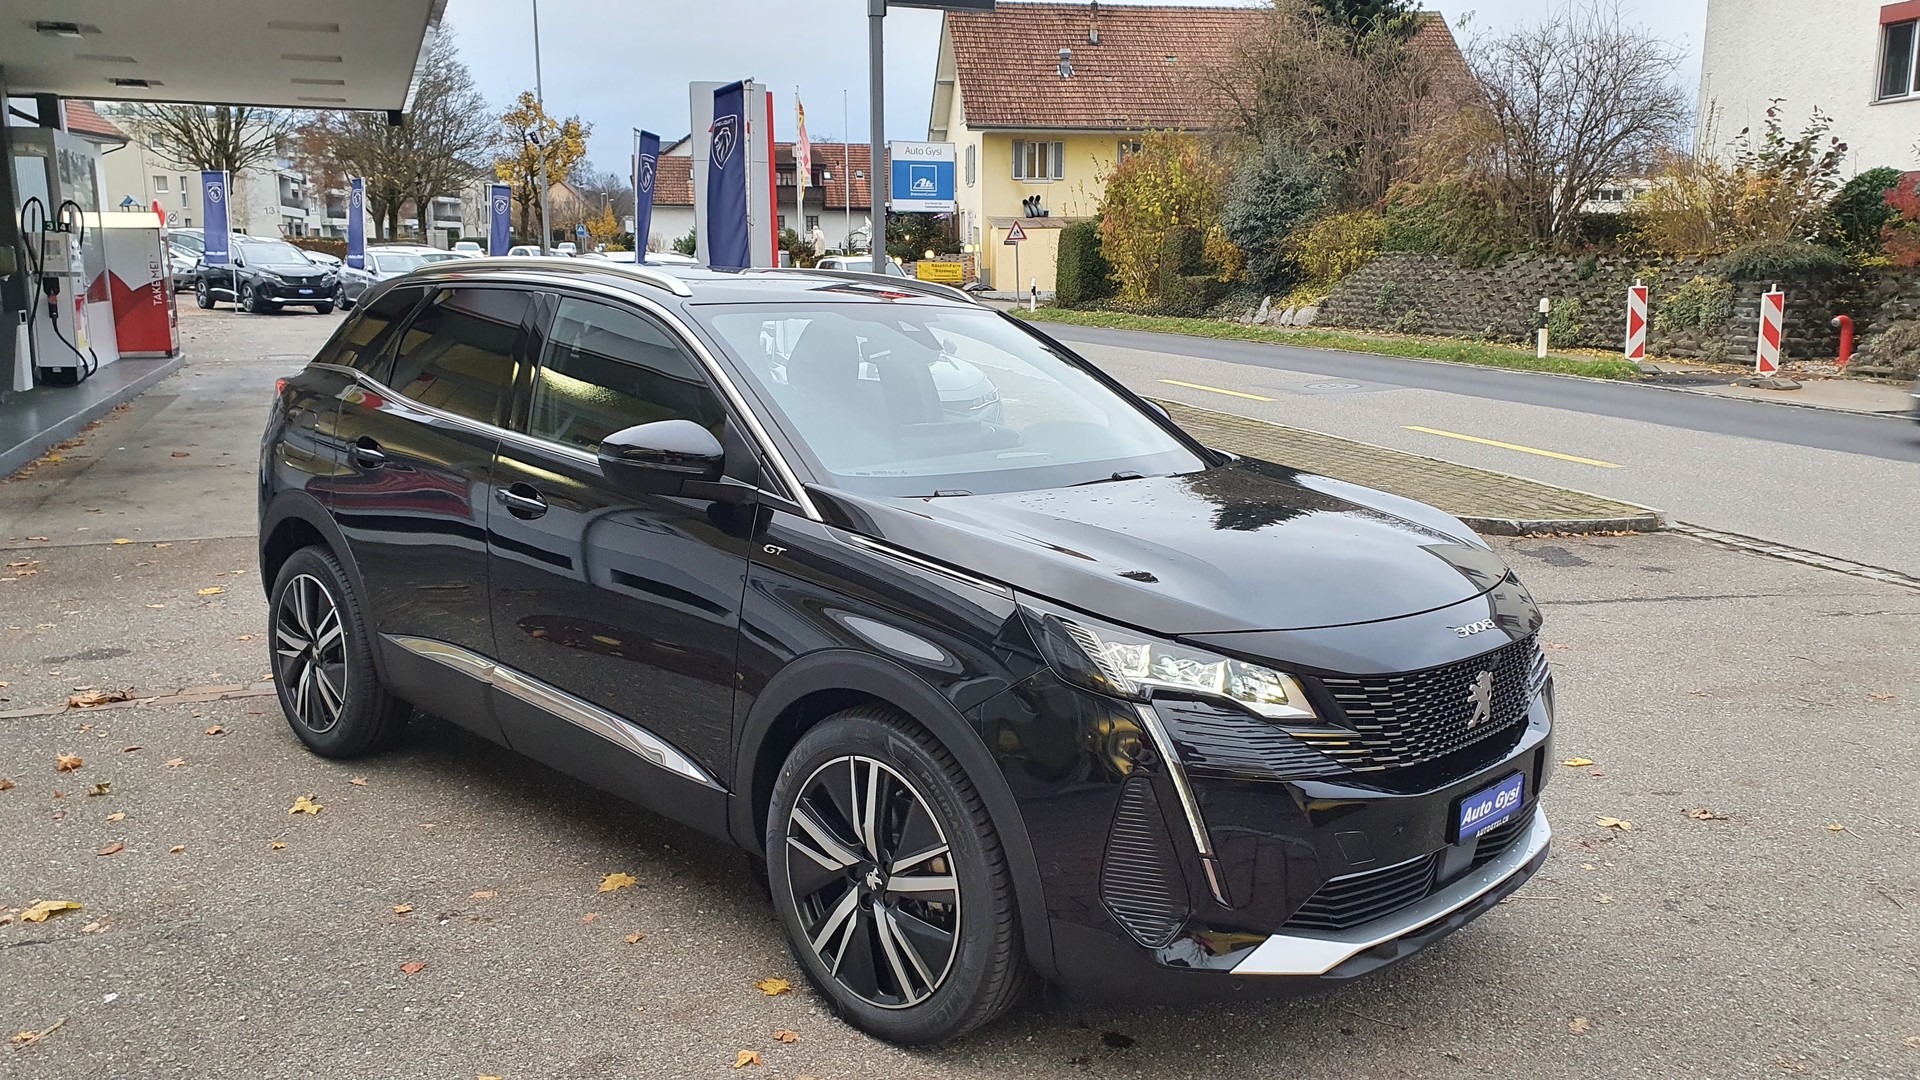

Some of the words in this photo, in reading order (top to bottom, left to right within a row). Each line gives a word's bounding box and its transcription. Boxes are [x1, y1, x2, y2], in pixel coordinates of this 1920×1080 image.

[905, 146, 924, 155] Auto
[925, 146, 943, 156] Gysi
[263, 206, 276, 215] 13
[46, 222, 55, 230] 3
[59, 223, 67, 231] 4
[149, 260, 160, 279] ME!
[151, 279, 163, 306] TAKE
[763, 543, 788, 556] GT
[1453, 618, 1497, 639] 3008
[1460, 800, 1493, 826] Auto
[1494, 781, 1521, 810] Gysi
